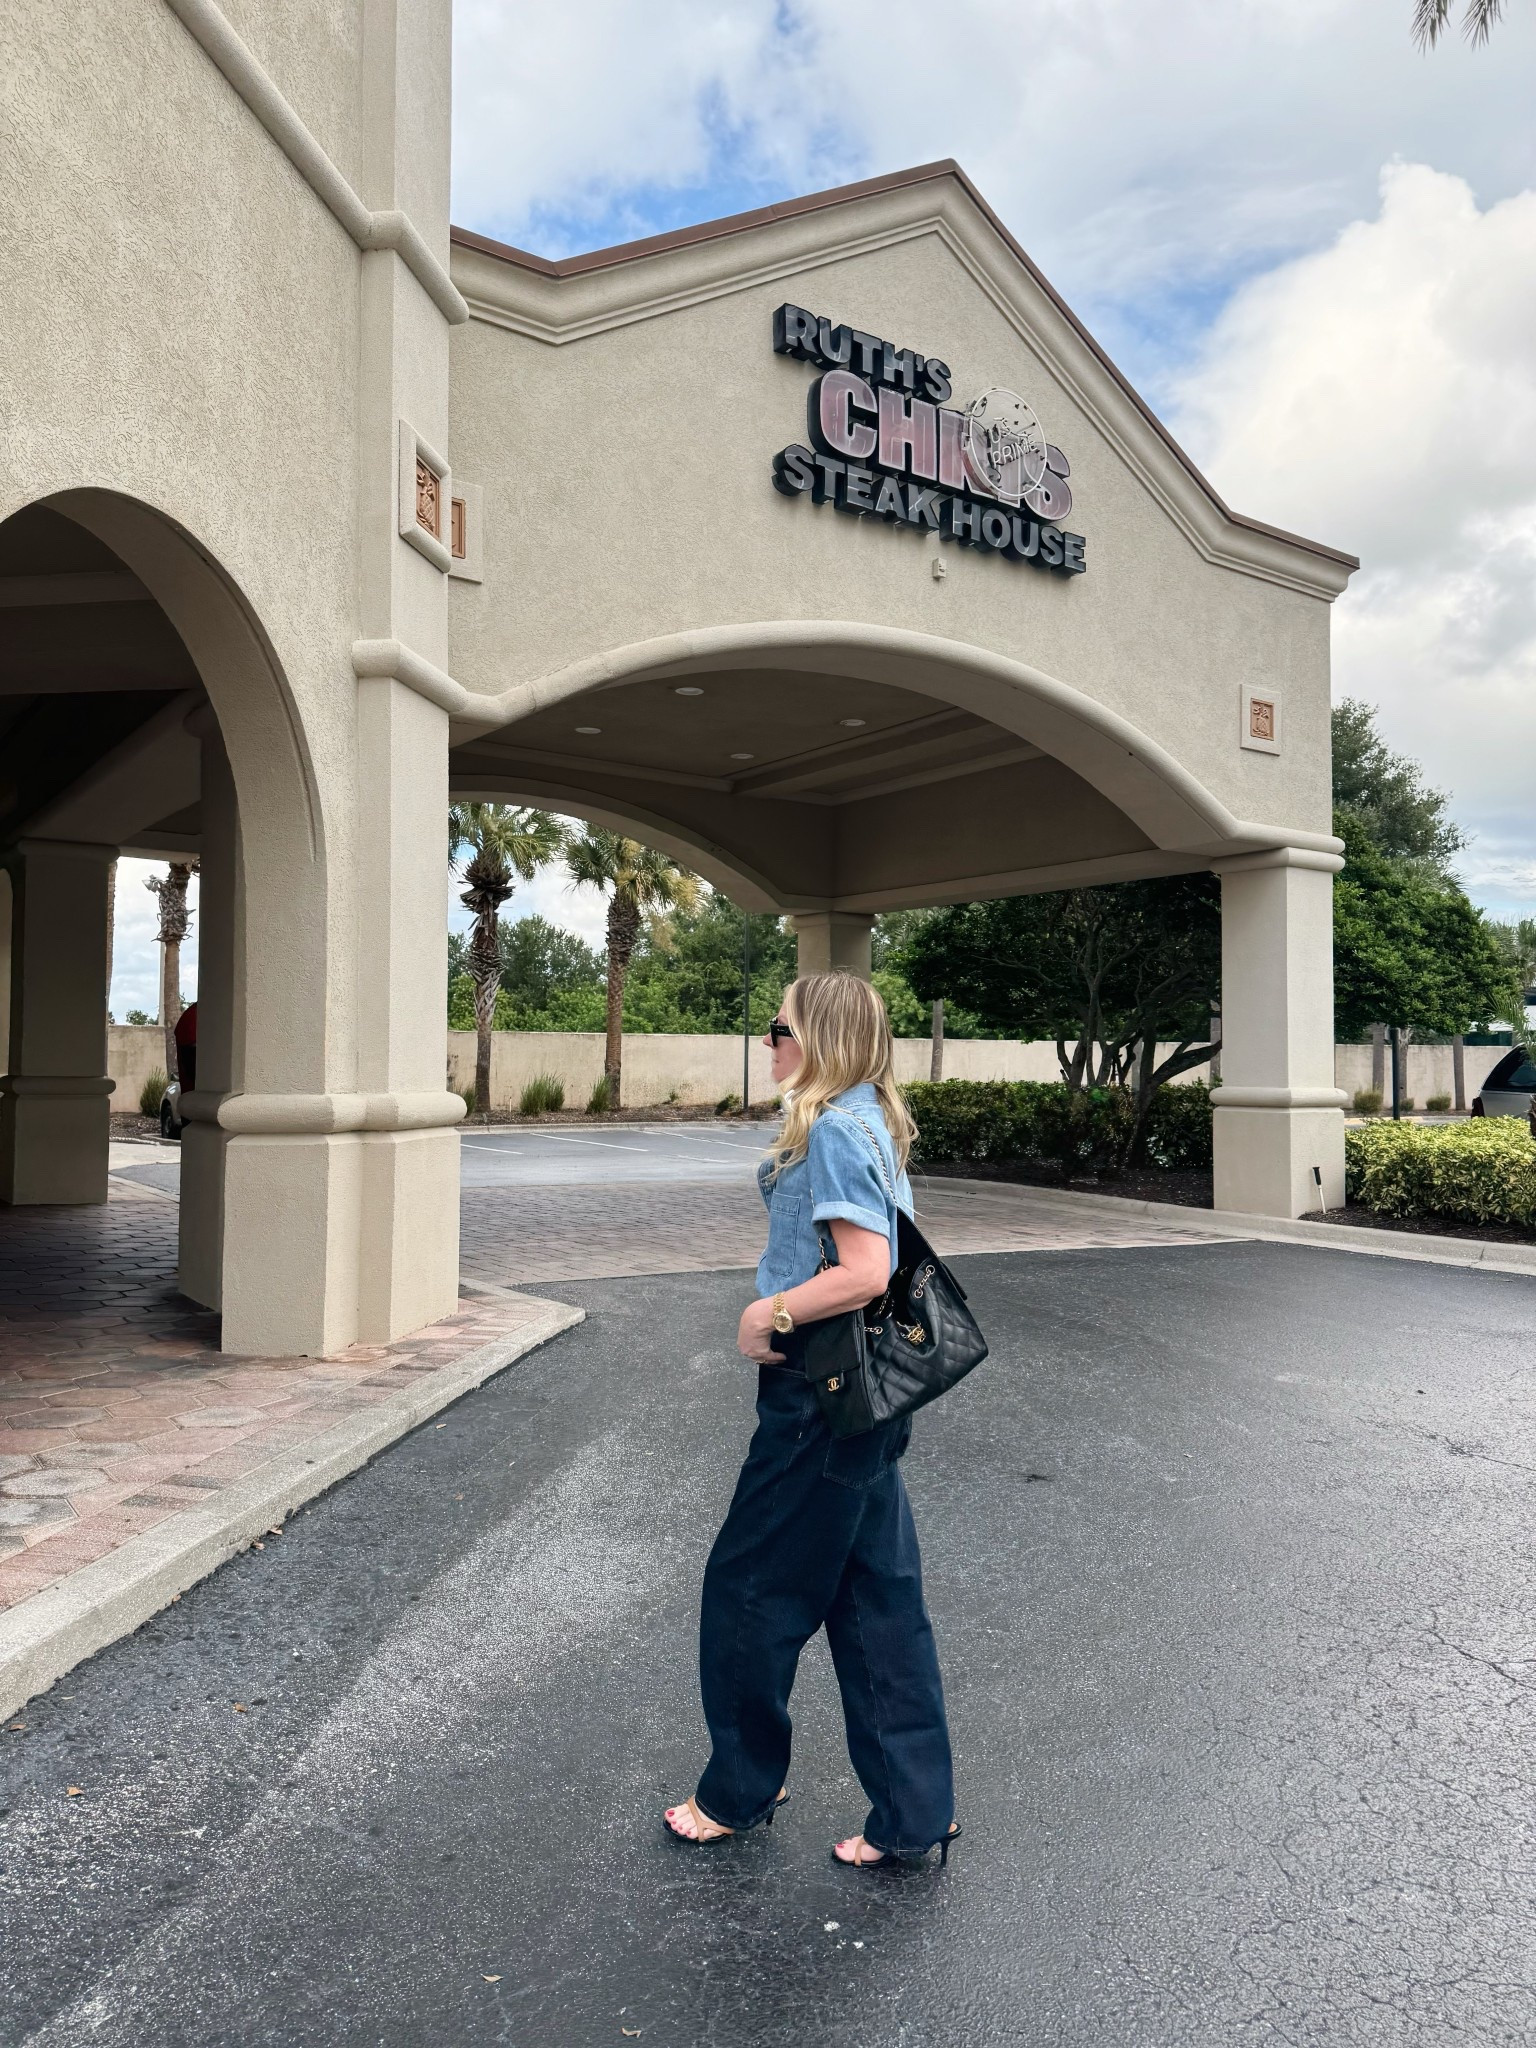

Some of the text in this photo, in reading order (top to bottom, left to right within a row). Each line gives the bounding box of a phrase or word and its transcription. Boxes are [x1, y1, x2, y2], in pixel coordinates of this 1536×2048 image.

[774, 303, 952, 402] RUTH'S
[773, 444, 1087, 578] STEAK HOUSE
